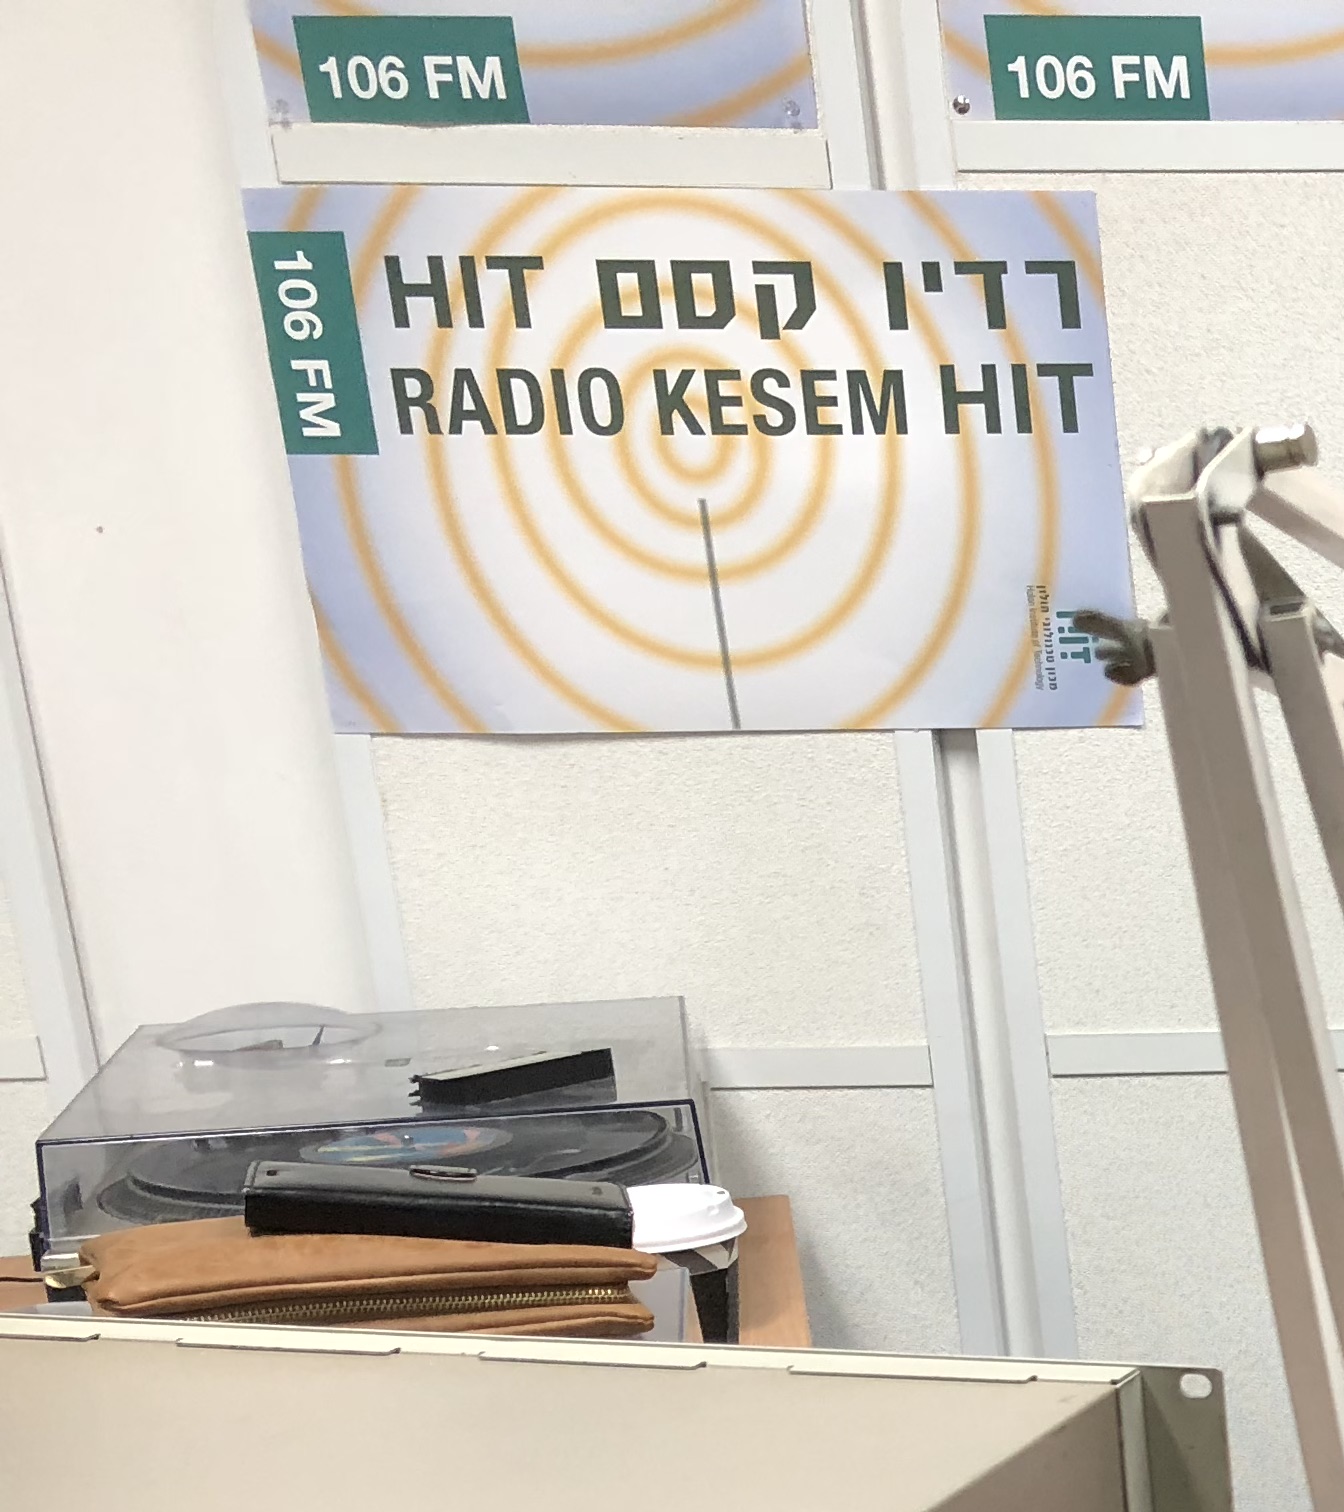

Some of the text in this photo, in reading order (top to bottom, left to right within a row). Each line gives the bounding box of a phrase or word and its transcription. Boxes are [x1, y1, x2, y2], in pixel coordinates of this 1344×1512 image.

[318, 56, 507, 99] 106 FM
[1007, 56, 1191, 99] 106 FM
[384, 255, 1081, 339] רדיו קסם HIT
[271, 250, 341, 439] 106 FM
[391, 362, 1094, 436] RADIO KESEM HIT
